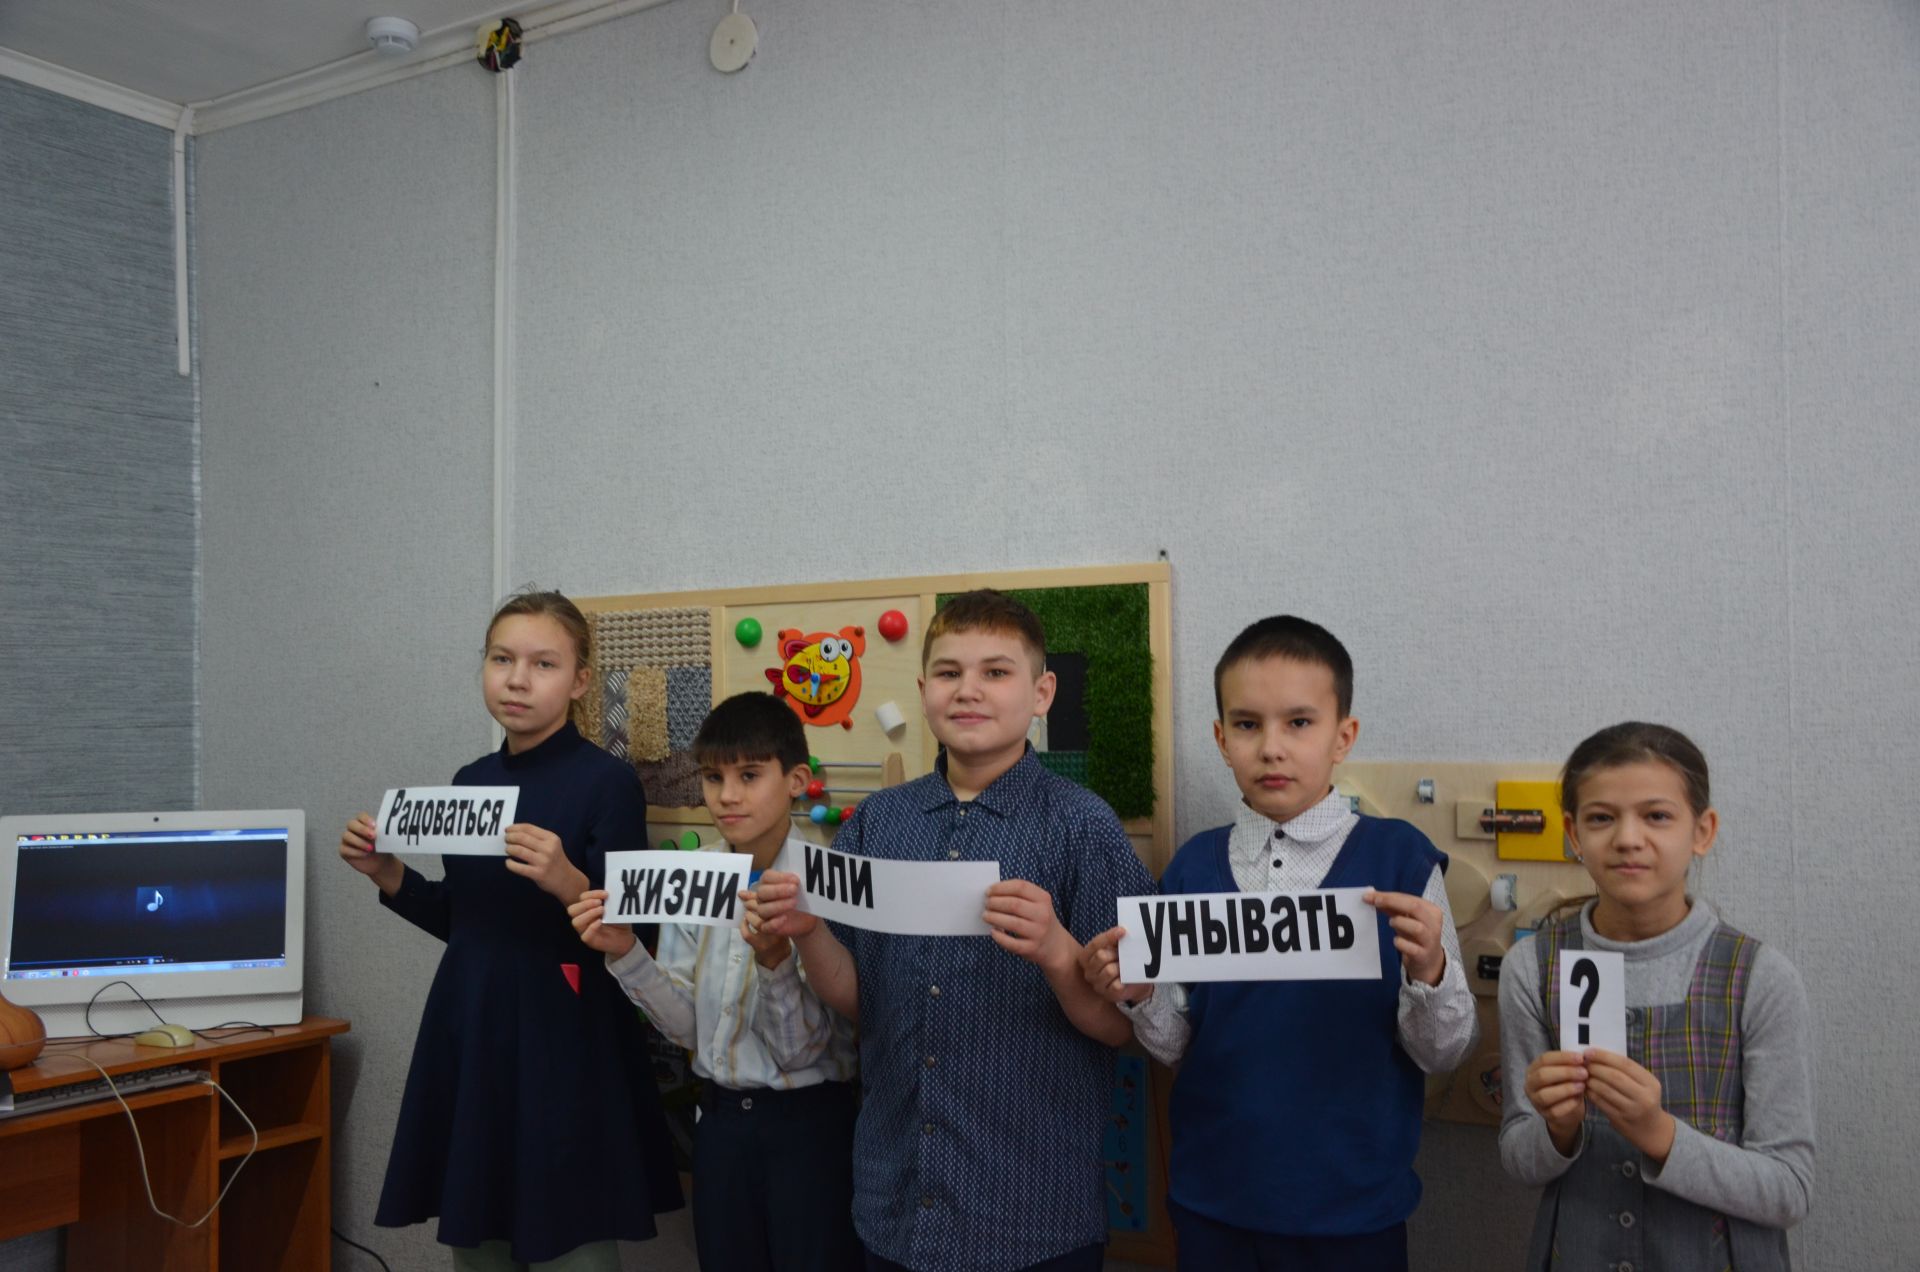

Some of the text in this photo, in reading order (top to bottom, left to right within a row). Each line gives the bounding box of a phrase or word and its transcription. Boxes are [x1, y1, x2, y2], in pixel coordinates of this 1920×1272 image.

[385, 789, 505, 845] Радоваться
[618, 868, 739, 920] жизни
[1138, 895, 1355, 979] унывать
[1570, 958, 1600, 1045] ?
